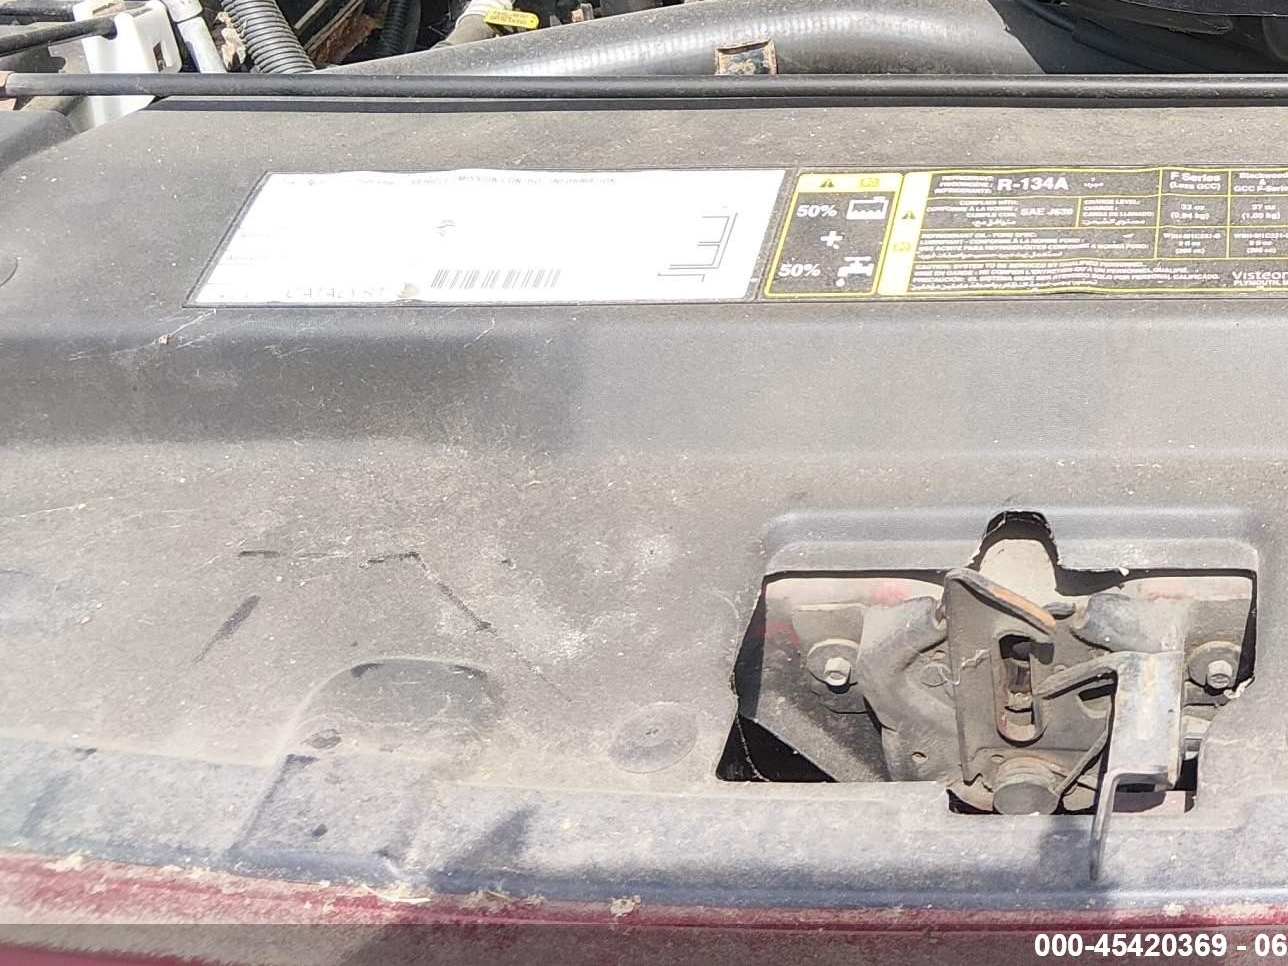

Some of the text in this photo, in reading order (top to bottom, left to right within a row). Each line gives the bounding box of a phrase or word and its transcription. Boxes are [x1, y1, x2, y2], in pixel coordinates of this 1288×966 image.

[1182, 173, 1221, 181] Series
[997, 177, 1069, 191] R-134A
[796, 204, 838, 217] 50%
[1020, 208, 1045, 216] SAE
[779, 263, 821, 277] 50%
